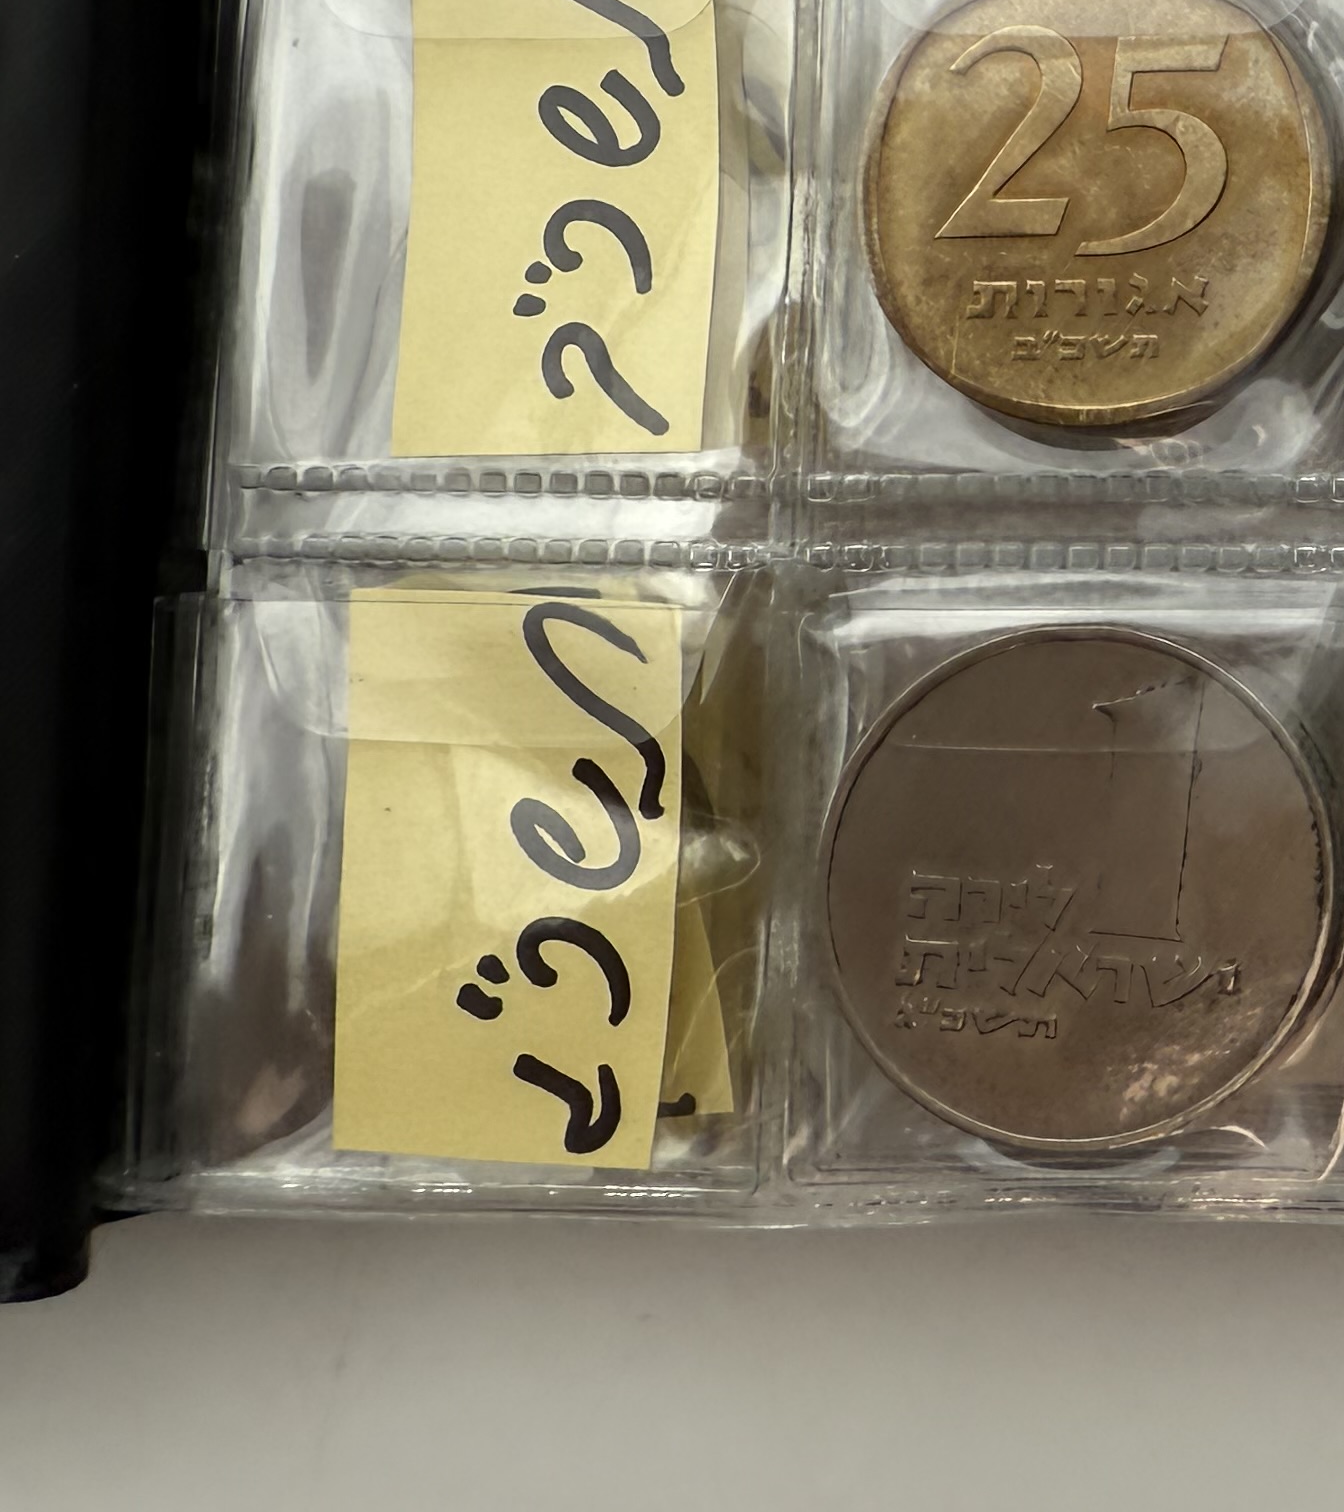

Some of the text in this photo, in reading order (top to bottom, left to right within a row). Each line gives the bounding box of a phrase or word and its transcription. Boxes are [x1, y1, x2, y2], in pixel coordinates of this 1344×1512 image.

[934, 24, 1230, 257] 25
[965, 272, 1210, 321] אגורות
[1091, 674, 1207, 944] 1
